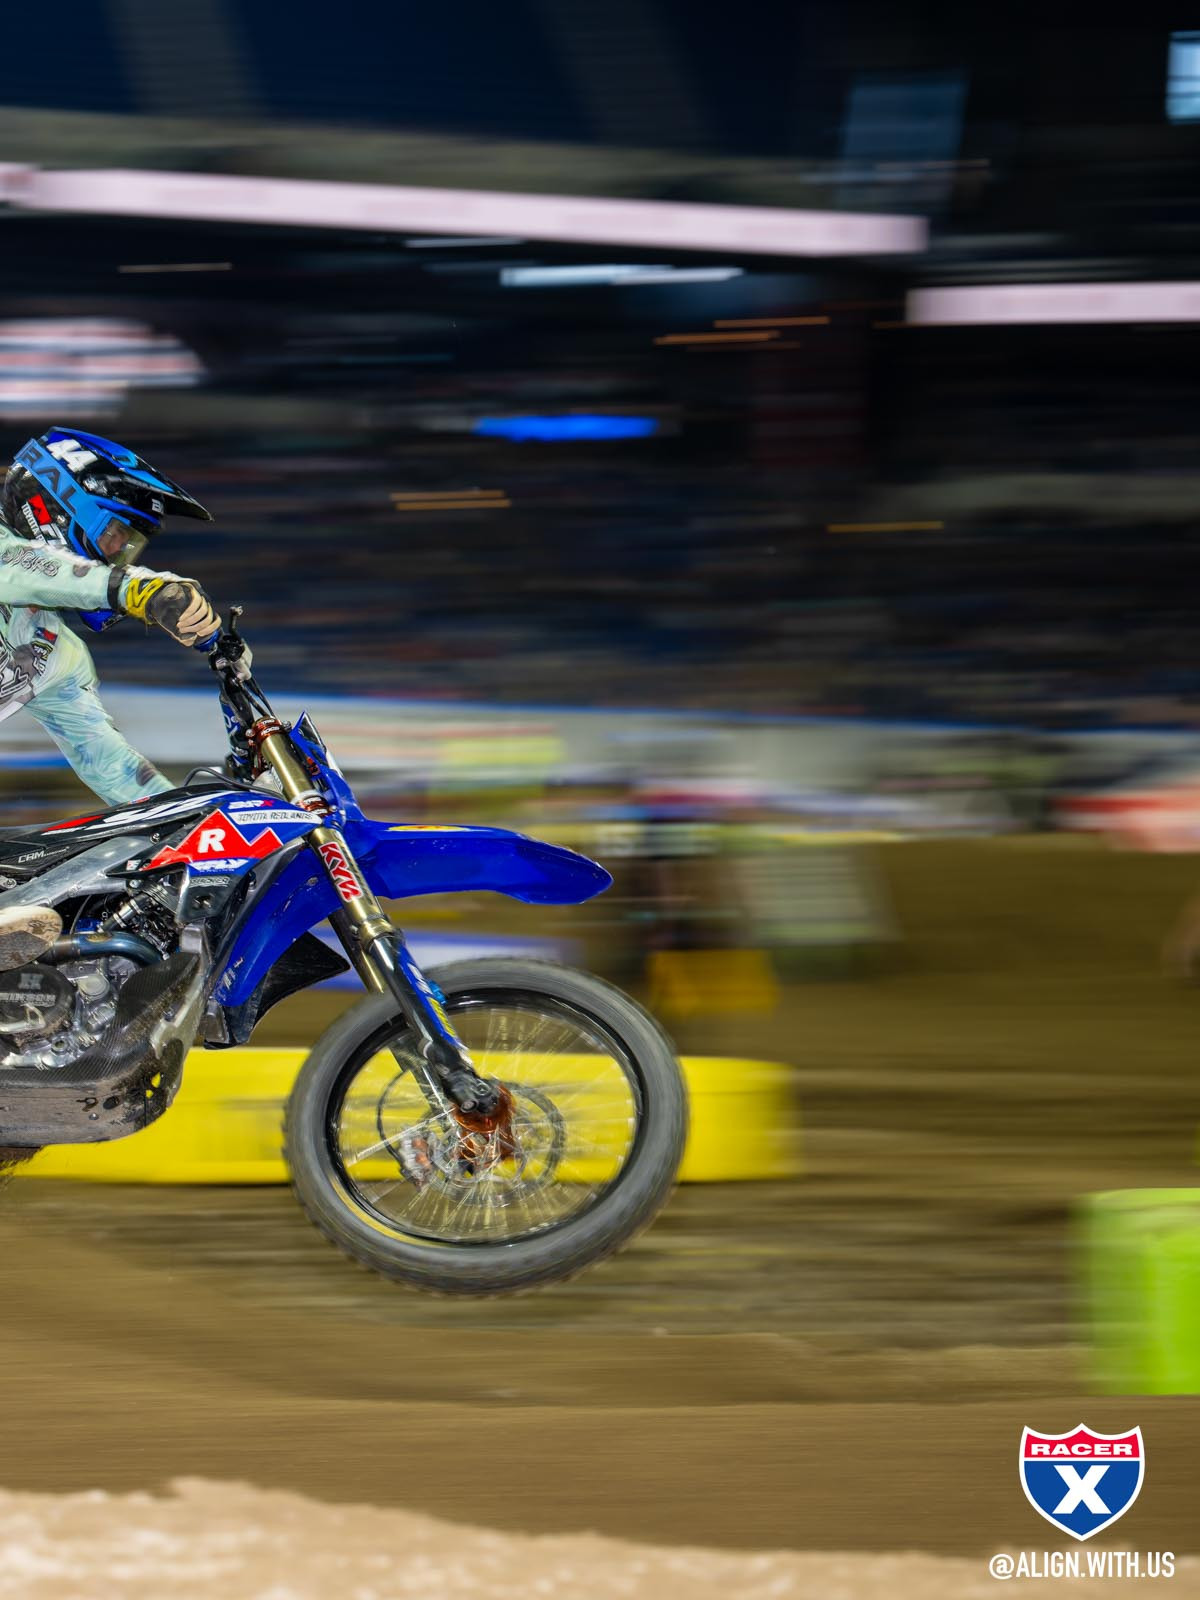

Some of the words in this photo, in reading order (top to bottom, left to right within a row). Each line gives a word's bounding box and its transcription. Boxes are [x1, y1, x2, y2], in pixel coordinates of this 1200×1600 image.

[46, 439, 98, 473] 44
[238, 812, 267, 822] TOYOTA
[270, 812, 313, 820] REDLANDS
[197, 828, 226, 853] R
[18, 850, 45, 863] CRM
[319, 841, 364, 902] KYB
